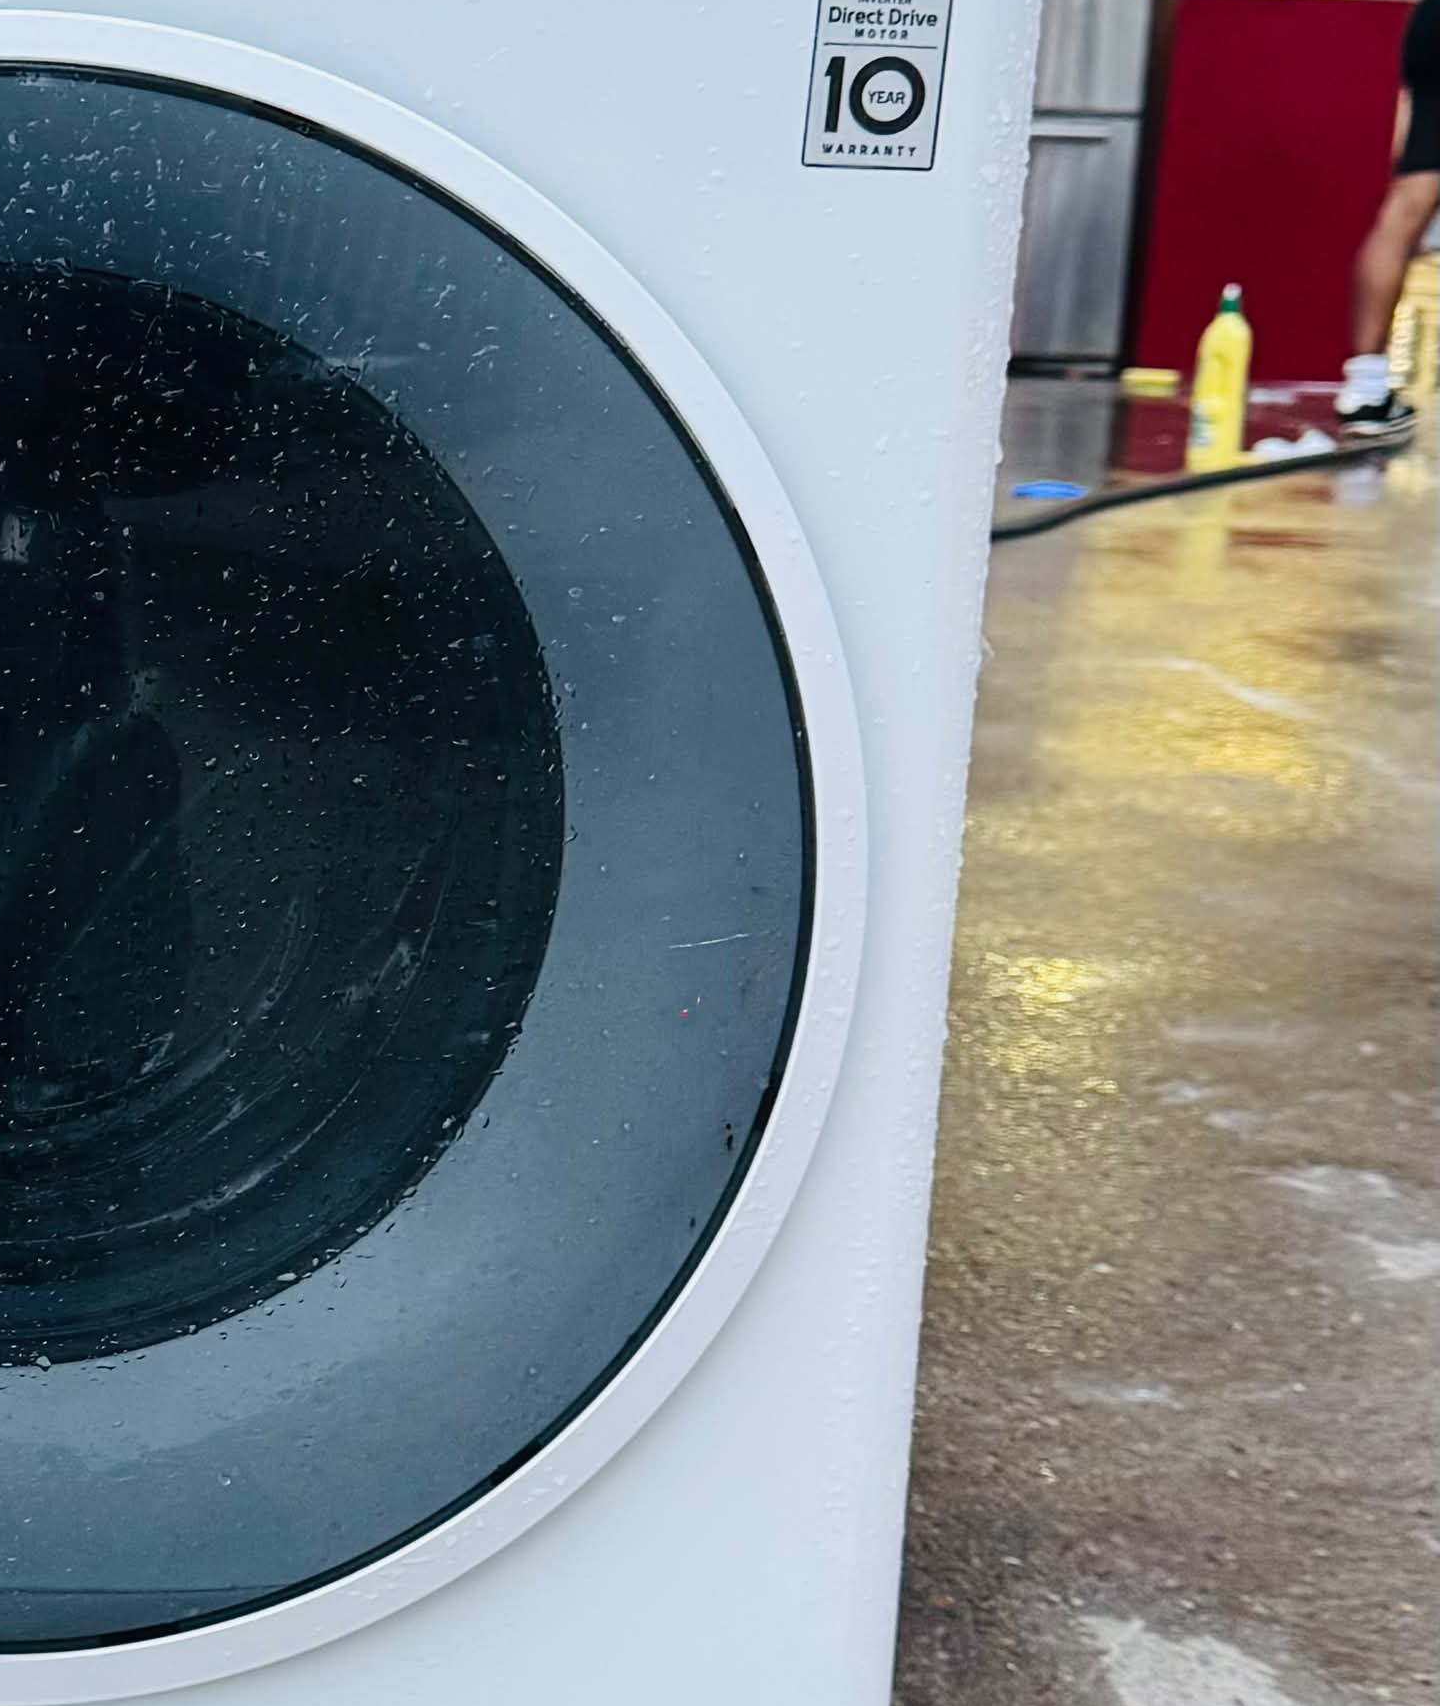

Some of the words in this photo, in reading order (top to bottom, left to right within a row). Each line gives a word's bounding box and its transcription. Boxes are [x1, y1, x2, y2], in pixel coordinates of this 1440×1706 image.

[828, 6, 884, 25] Direct
[888, 8, 938, 27] Drive
[854, 28, 909, 40] MOTOR
[824, 56, 926, 135] 10
[868, 91, 906, 105] YEAR
[822, 143, 916, 157] WARRANTY
